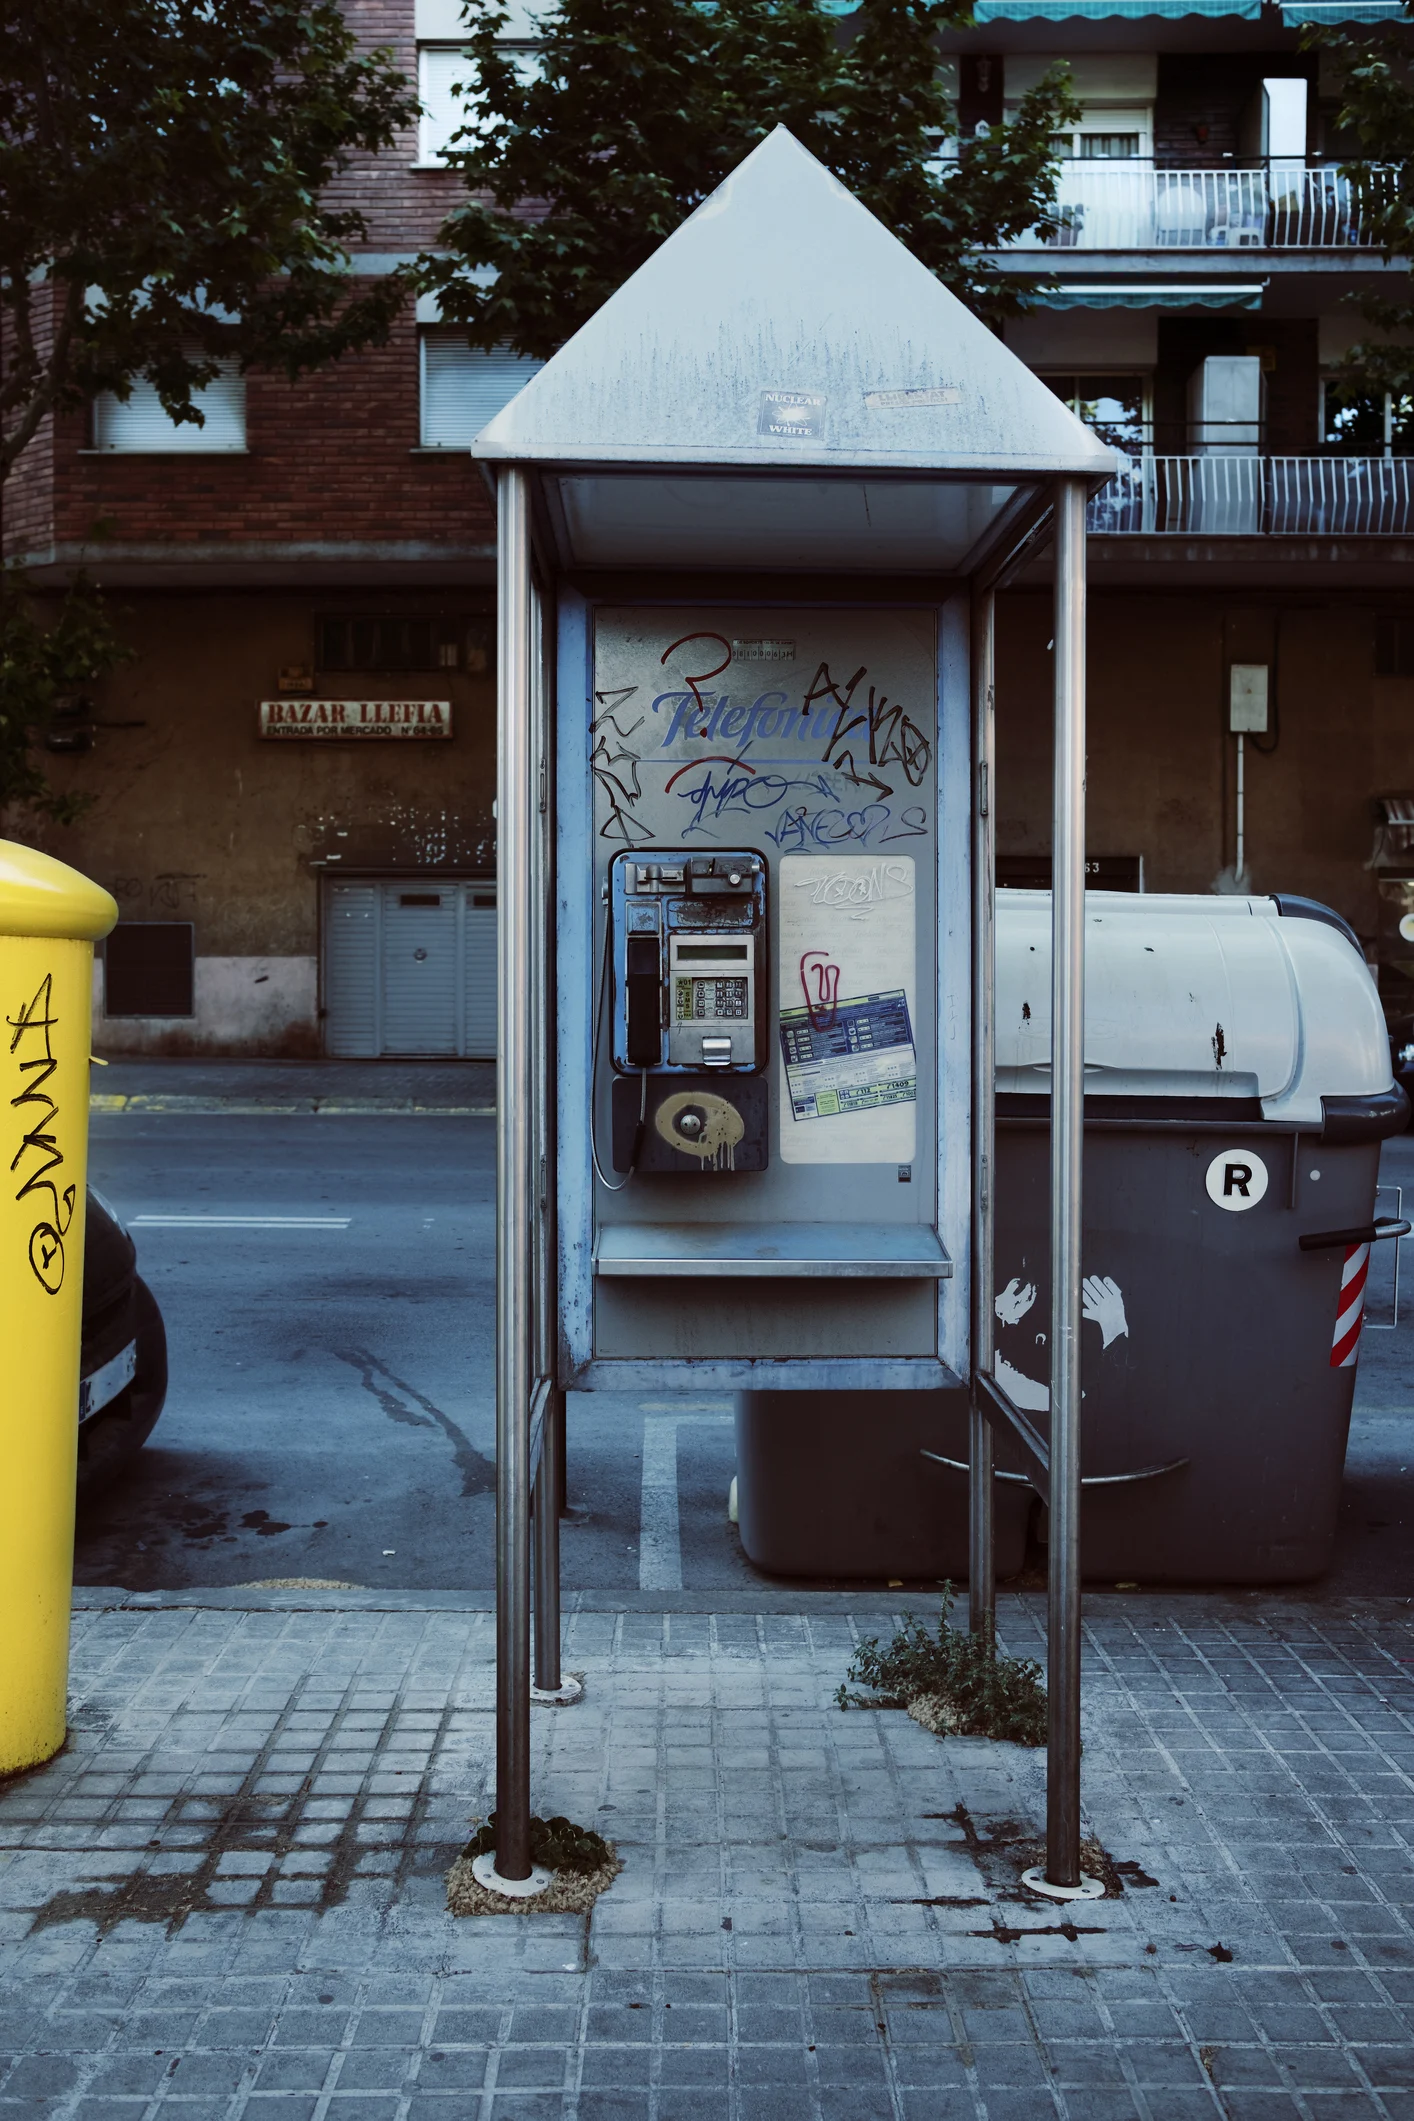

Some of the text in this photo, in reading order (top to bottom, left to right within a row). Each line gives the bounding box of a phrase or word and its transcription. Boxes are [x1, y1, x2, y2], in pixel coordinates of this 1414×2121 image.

[764, 393, 821, 407] NUCLEAR
[768, 424, 813, 437] WHITE
[266, 703, 444, 724] BAZAR LLEFIA
[266, 725, 314, 736] ENTRADA
[316, 725, 339, 736] POR
[341, 725, 392, 736] MERCADO
[1084, 862, 1100, 873] 63
[1223, 1163, 1254, 1197] R
